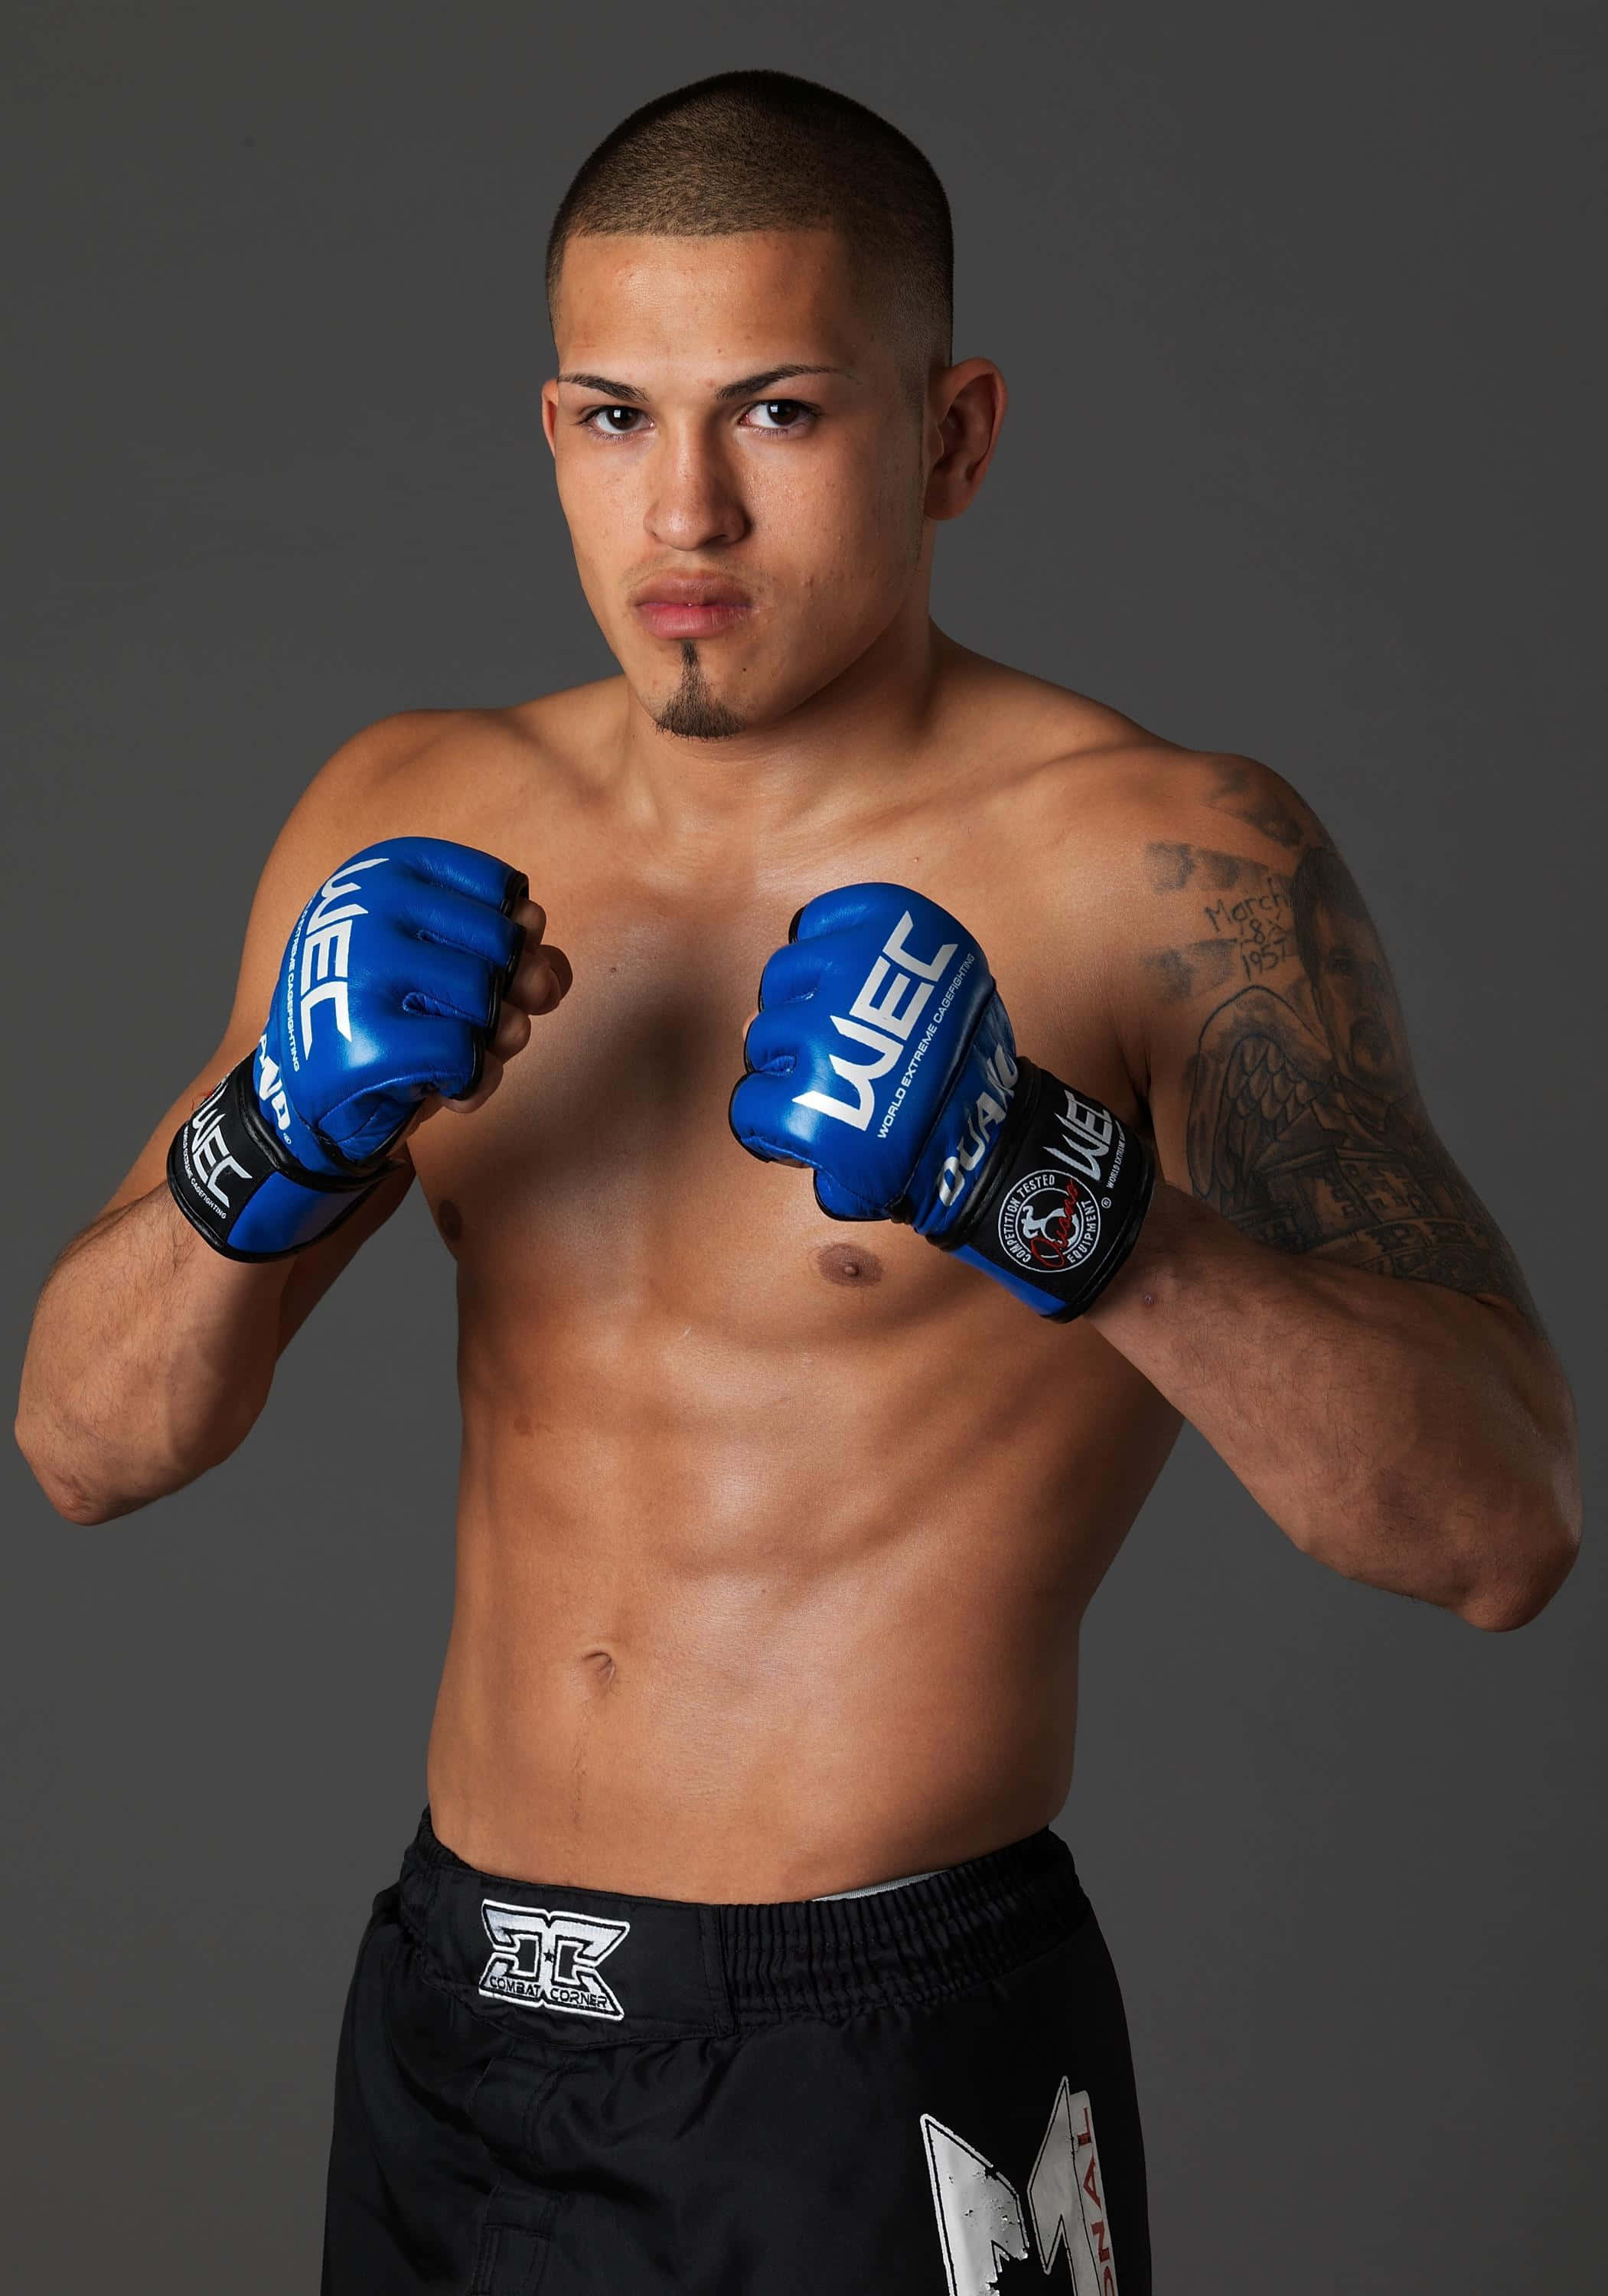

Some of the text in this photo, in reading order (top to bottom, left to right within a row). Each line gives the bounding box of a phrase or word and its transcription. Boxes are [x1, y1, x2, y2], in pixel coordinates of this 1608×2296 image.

[1205, 877, 1289, 932] March
[300, 858, 390, 1061] WEC
[287, 973, 300, 1071] CAGEFIGHTING
[791, 910, 958, 1130] WEC
[877, 954, 975, 1139] WORLD EXTREME CAGEFIGHTING
[192, 1082, 253, 1208] WEC
[1042, 1090, 1113, 1181] WEC
[1106, 1164, 1120, 1189] WORLD
[191, 1178, 227, 1219] CAGEFIGHTING
[1003, 1174, 1055, 1263] COMPETITION TESTED
[1067, 1199, 1097, 1263] EQUIPMENT
[490, 1976, 607, 2008] COMBAT CORNER
